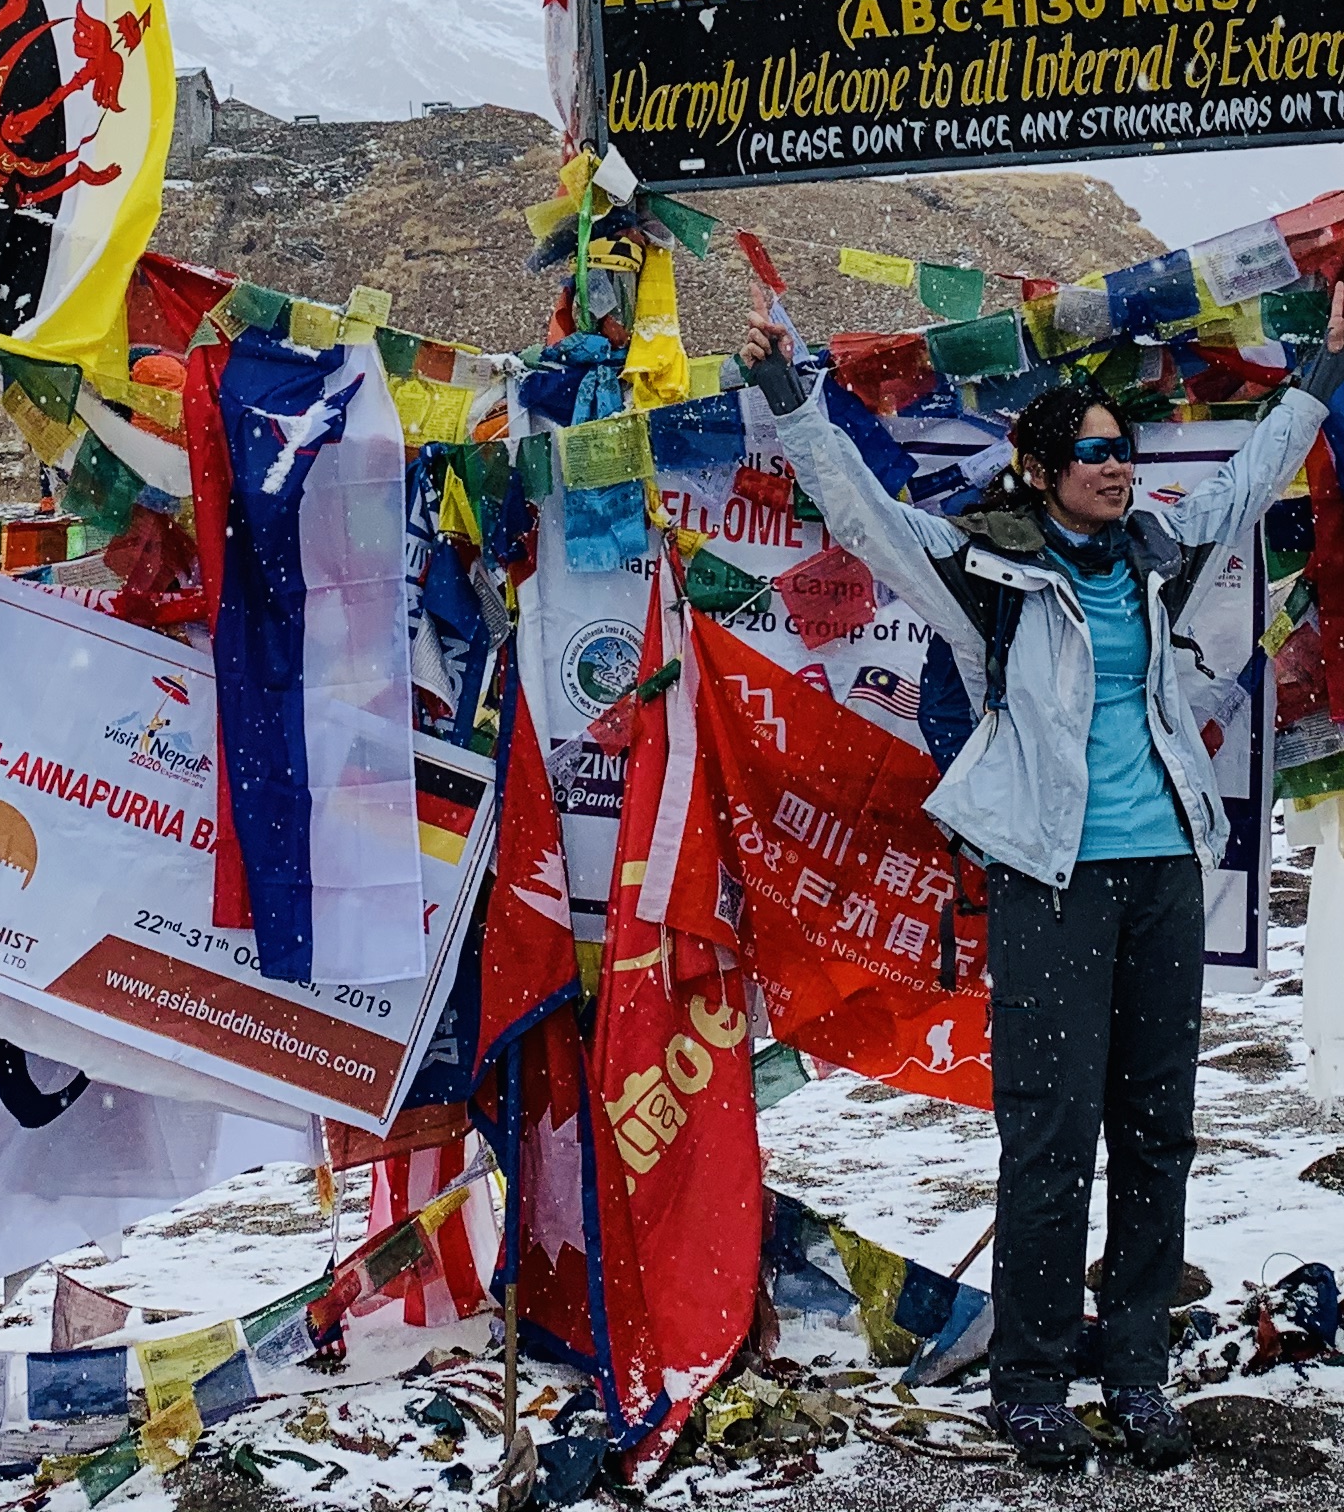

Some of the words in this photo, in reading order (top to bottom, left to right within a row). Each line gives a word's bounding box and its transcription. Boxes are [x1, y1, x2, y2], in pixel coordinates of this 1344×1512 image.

[608, 59, 749, 146] Warmly
[758, 47, 910, 121] Welcome
[919, 44, 953, 110] to
[961, 37, 1012, 106] all
[1023, 23, 1178, 103] Internal
[853, 119, 928, 156] DON'T
[935, 114, 1013, 152] PLACE
[1021, 110, 1074, 142] ANY
[1280, 89, 1311, 123] ON
[784, 613, 867, 644] Group
[873, 619, 901, 642] of
[128, 751, 162, 772] 2020
[830, 937, 925, 993] Nanchong
[105, 968, 377, 1084] www.asiabuddhisttours.com
[333, 984, 392, 1019] 2019
